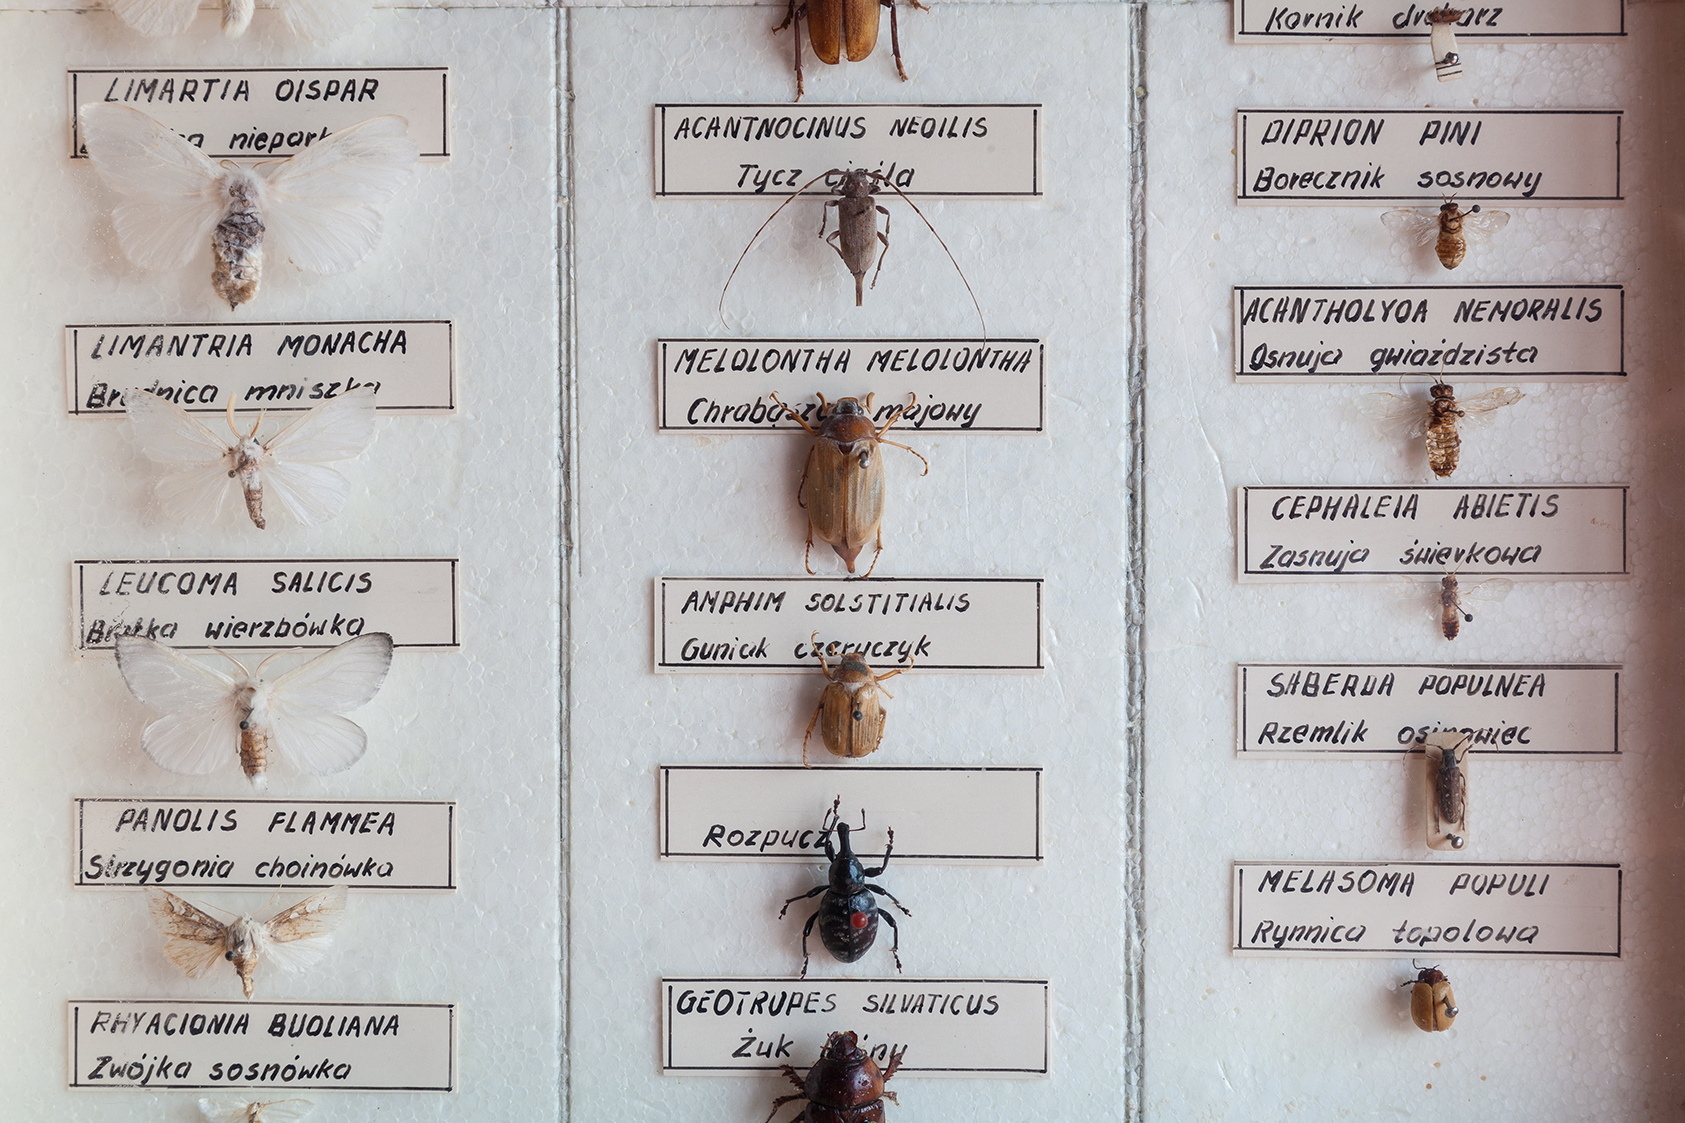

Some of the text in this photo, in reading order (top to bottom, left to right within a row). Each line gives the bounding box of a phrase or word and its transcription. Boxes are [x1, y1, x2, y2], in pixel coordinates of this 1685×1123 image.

[1263, 3, 1364, 33] Kornik
[1260, 118, 1483, 147] DIPRION PINI
[736, 163, 803, 193] Tycz
[1252, 161, 1543, 198] Borecznik sosnowy
[1452, 296, 1603, 324] NEMORALIS
[90, 329, 407, 360] LIMANTRIA MONACHA
[1248, 340, 1343, 374] Osnuja
[673, 347, 1033, 375] MELOLONTHA MELOLONTHA
[1271, 492, 1560, 520] CEPHALEIA ABIETIS
[1259, 539, 1370, 571] Zasnuja
[99, 571, 373, 597] LEUCOMA SALICIS
[804, 592, 971, 615] SOLSTITIALIS
[204, 613, 365, 640] wierzbówka
[680, 636, 769, 662] Guniak
[1417, 672, 1547, 698] POPULNEA
[1257, 719, 1369, 745] Rzemlik
[115, 807, 396, 836] PANOLIS FLAMMEA
[254, 854, 394, 879] choinówka
[1257, 869, 1550, 898] MELASOMA POPULI
[676, 988, 1000, 1016] GEOTRUPES SILVATICUS
[90, 1010, 400, 1039] RHYACIONIA BUOLIANA
[731, 1027, 796, 1059] Żuk
[88, 1053, 353, 1085] Zwójka sosnówka
